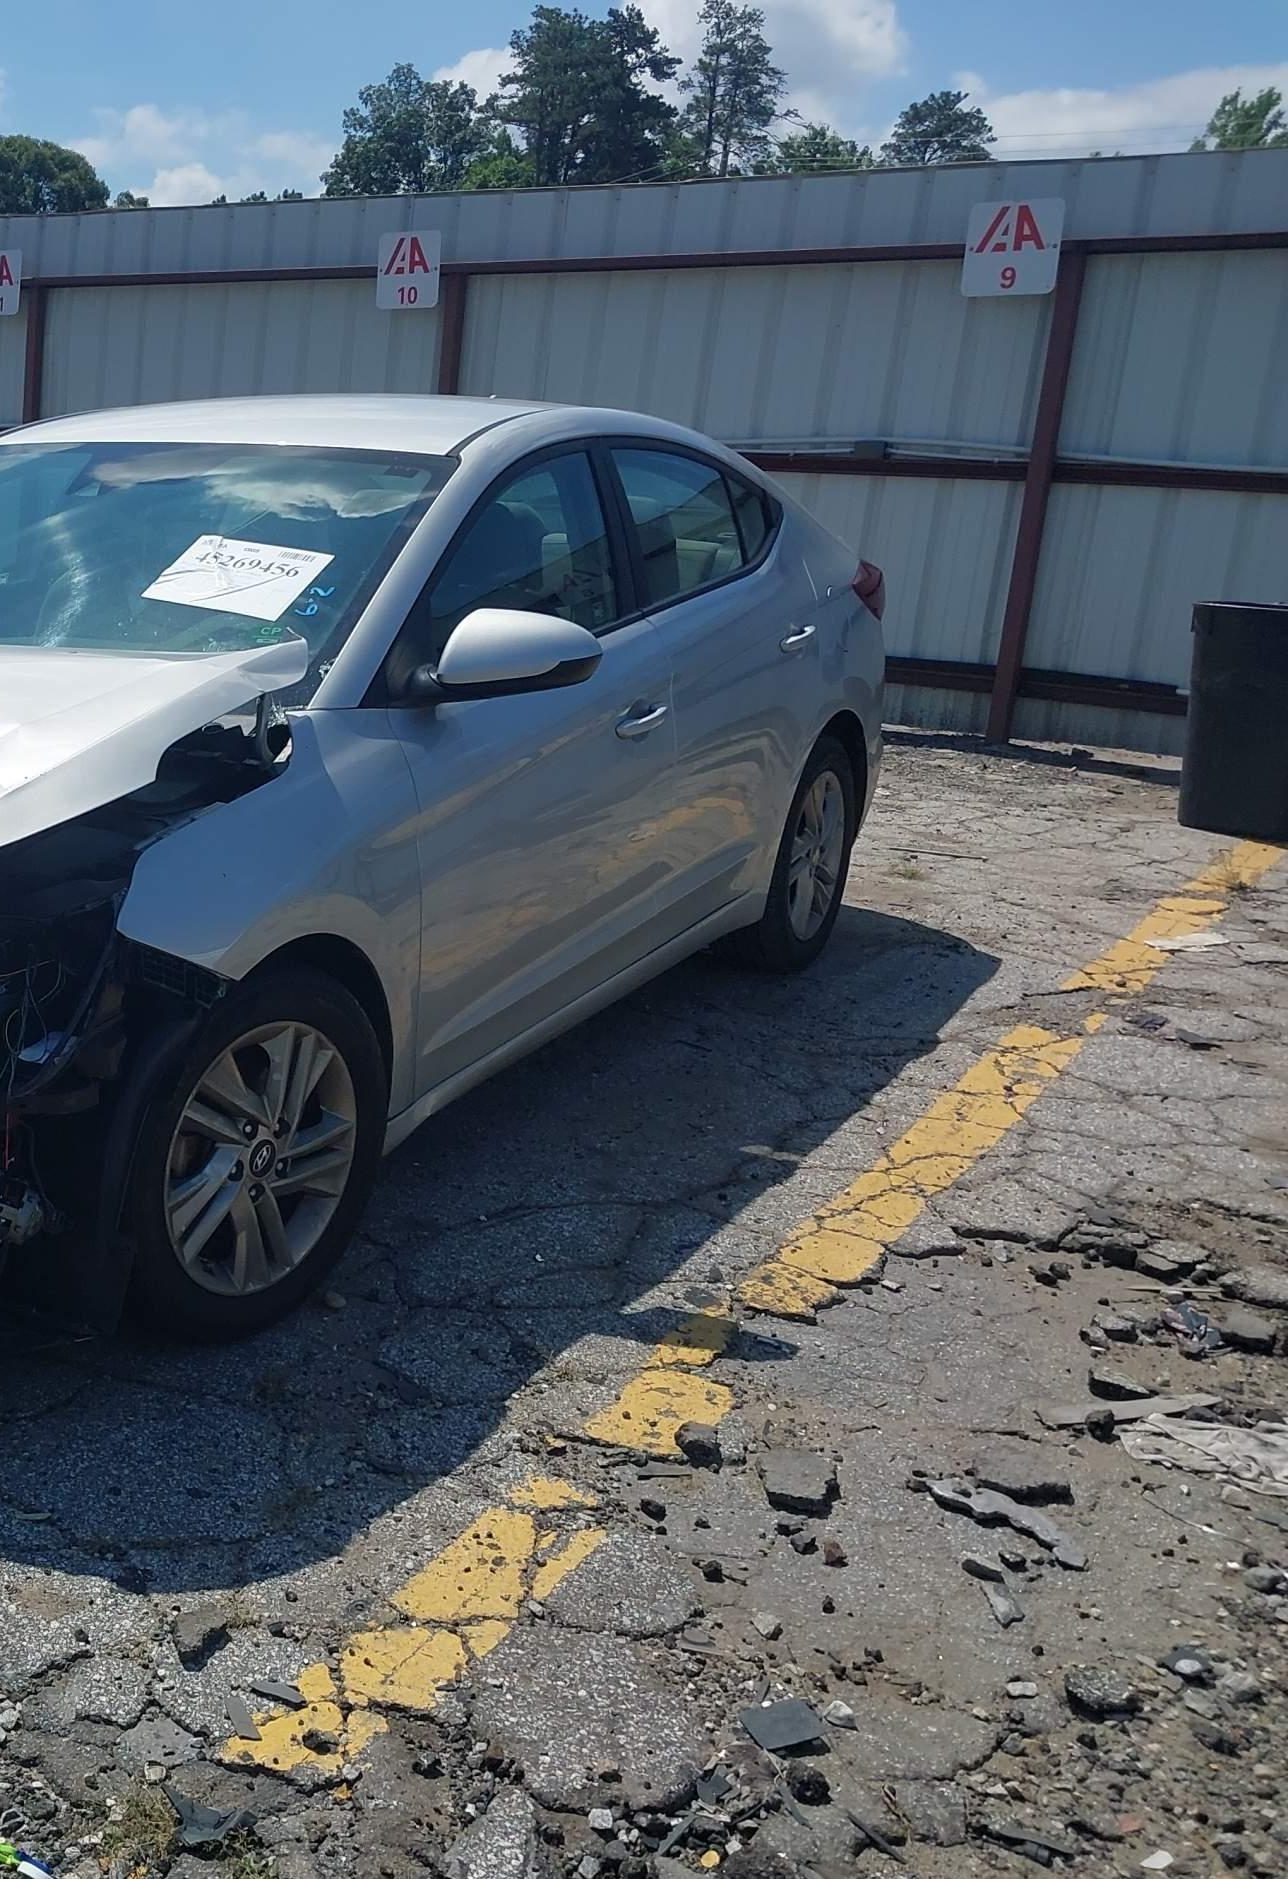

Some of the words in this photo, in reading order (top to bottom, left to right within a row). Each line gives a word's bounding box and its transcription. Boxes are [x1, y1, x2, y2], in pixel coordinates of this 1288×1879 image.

[999, 266, 1017, 289] 9
[397, 286, 418, 305] 10
[195, 551, 303, 578] 45269456
[260, 626, 283, 636] CP
